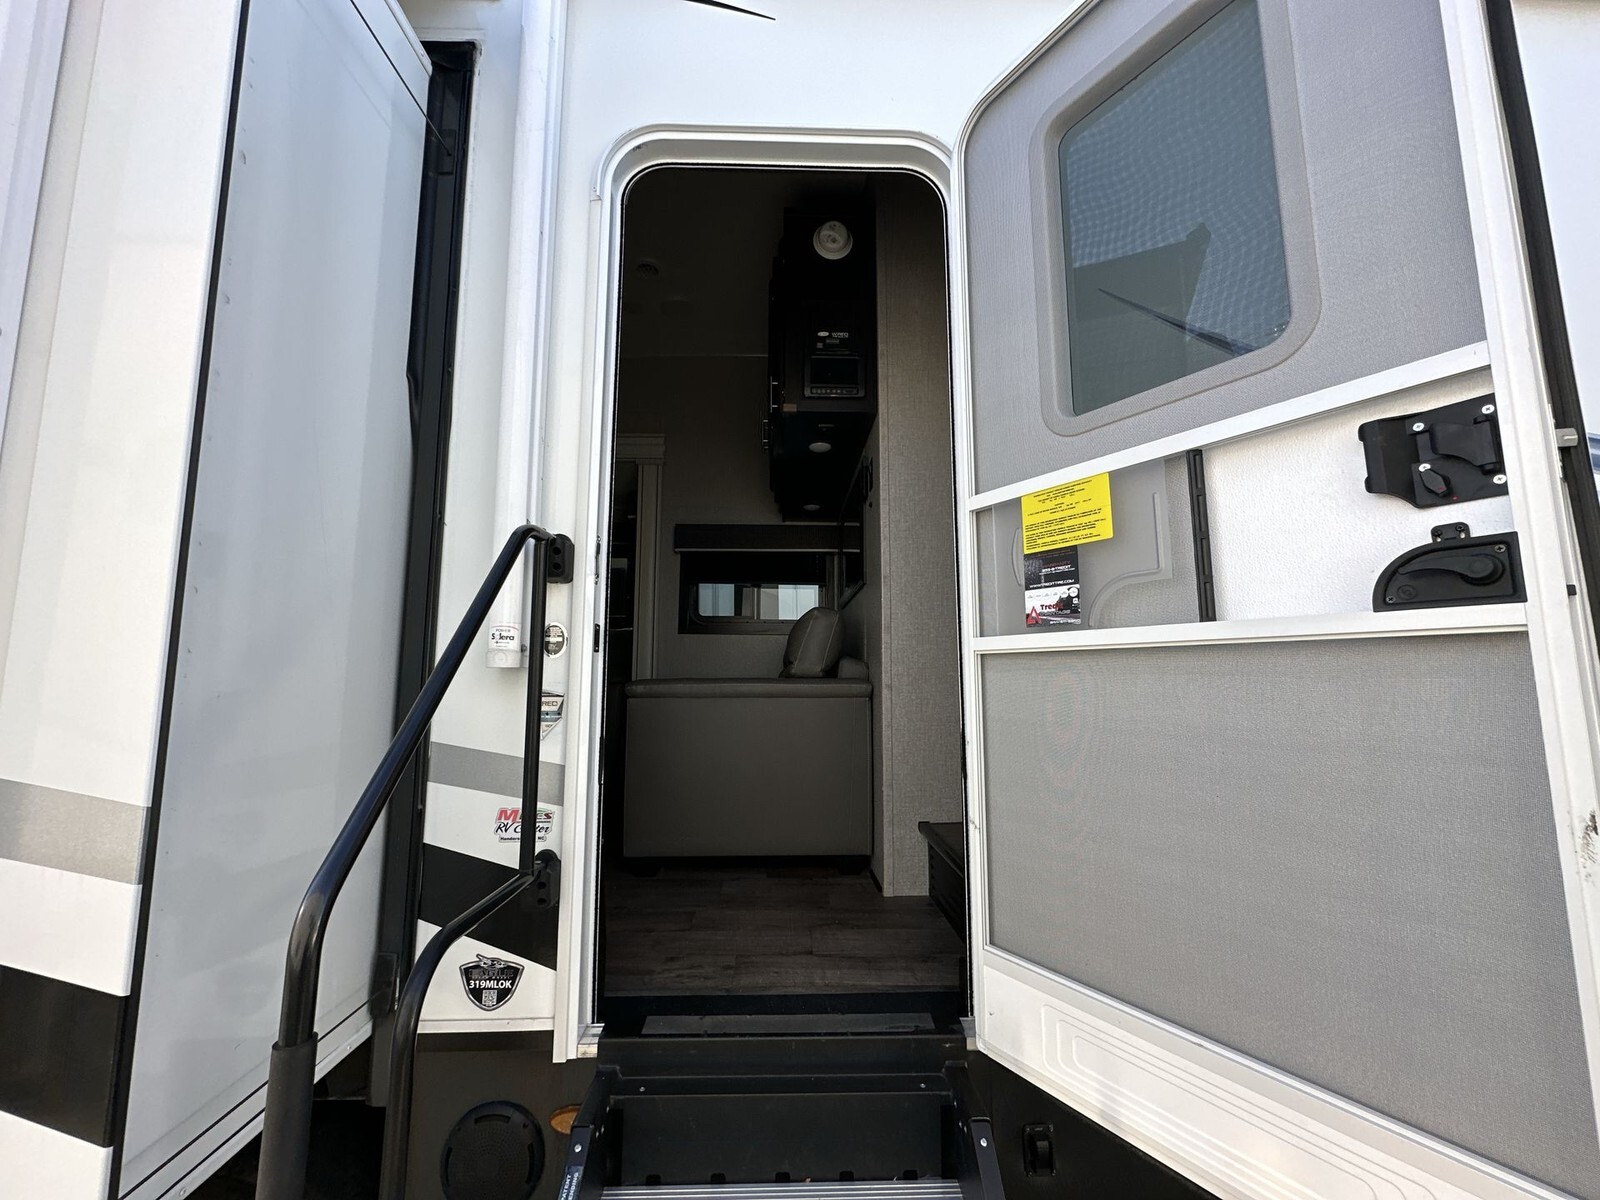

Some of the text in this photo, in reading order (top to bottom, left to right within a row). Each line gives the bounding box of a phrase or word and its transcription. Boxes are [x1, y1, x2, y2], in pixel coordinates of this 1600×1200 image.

[495, 821, 515, 833] RV
[468, 979, 513, 989] 319MLOK
[567, 1171, 580, 1200] ENDING
